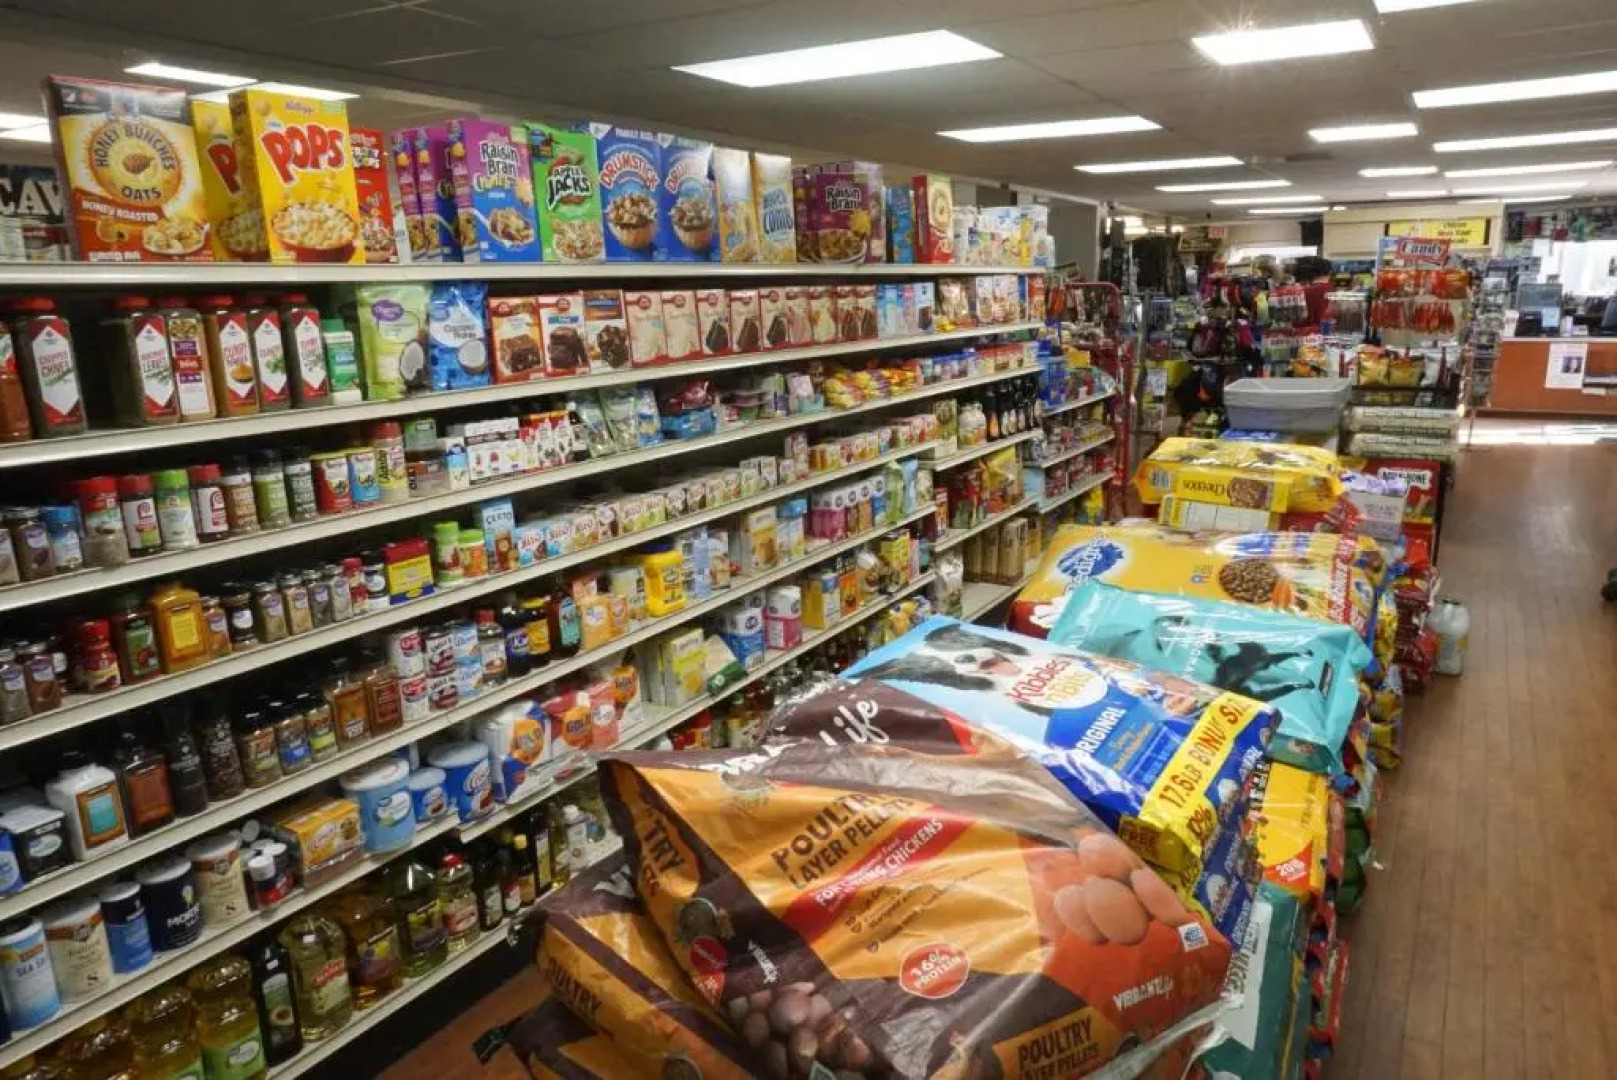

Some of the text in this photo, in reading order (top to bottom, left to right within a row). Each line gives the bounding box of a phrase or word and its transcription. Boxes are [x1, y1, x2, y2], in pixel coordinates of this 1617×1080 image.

[95, 128, 119, 166] HONEY
[126, 121, 175, 171] BUNCHES
[261, 124, 345, 184] POPS
[481, 141, 519, 161] Raisin
[487, 159, 518, 178] Bran
[601, 151, 659, 191] DRUMSTICK
[121, 186, 161, 201] OATS
[547, 174, 591, 209] JACKS
[826, 186, 860, 202] Raisin
[831, 199, 859, 212] Bran
[82, 200, 159, 222] HONEY ROASTED
[1401, 240, 1442, 256] Candy
[1074, 706, 1127, 755] RIGINAL
[1188, 715, 1227, 767] BONU
[788, 837, 849, 889] LAYER
[815, 883, 838, 907] FOR
[886, 817, 944, 873] CHICKENS
[910, 947, 954, 980] 16%
[1017, 1019, 1094, 1070] POULTRY
